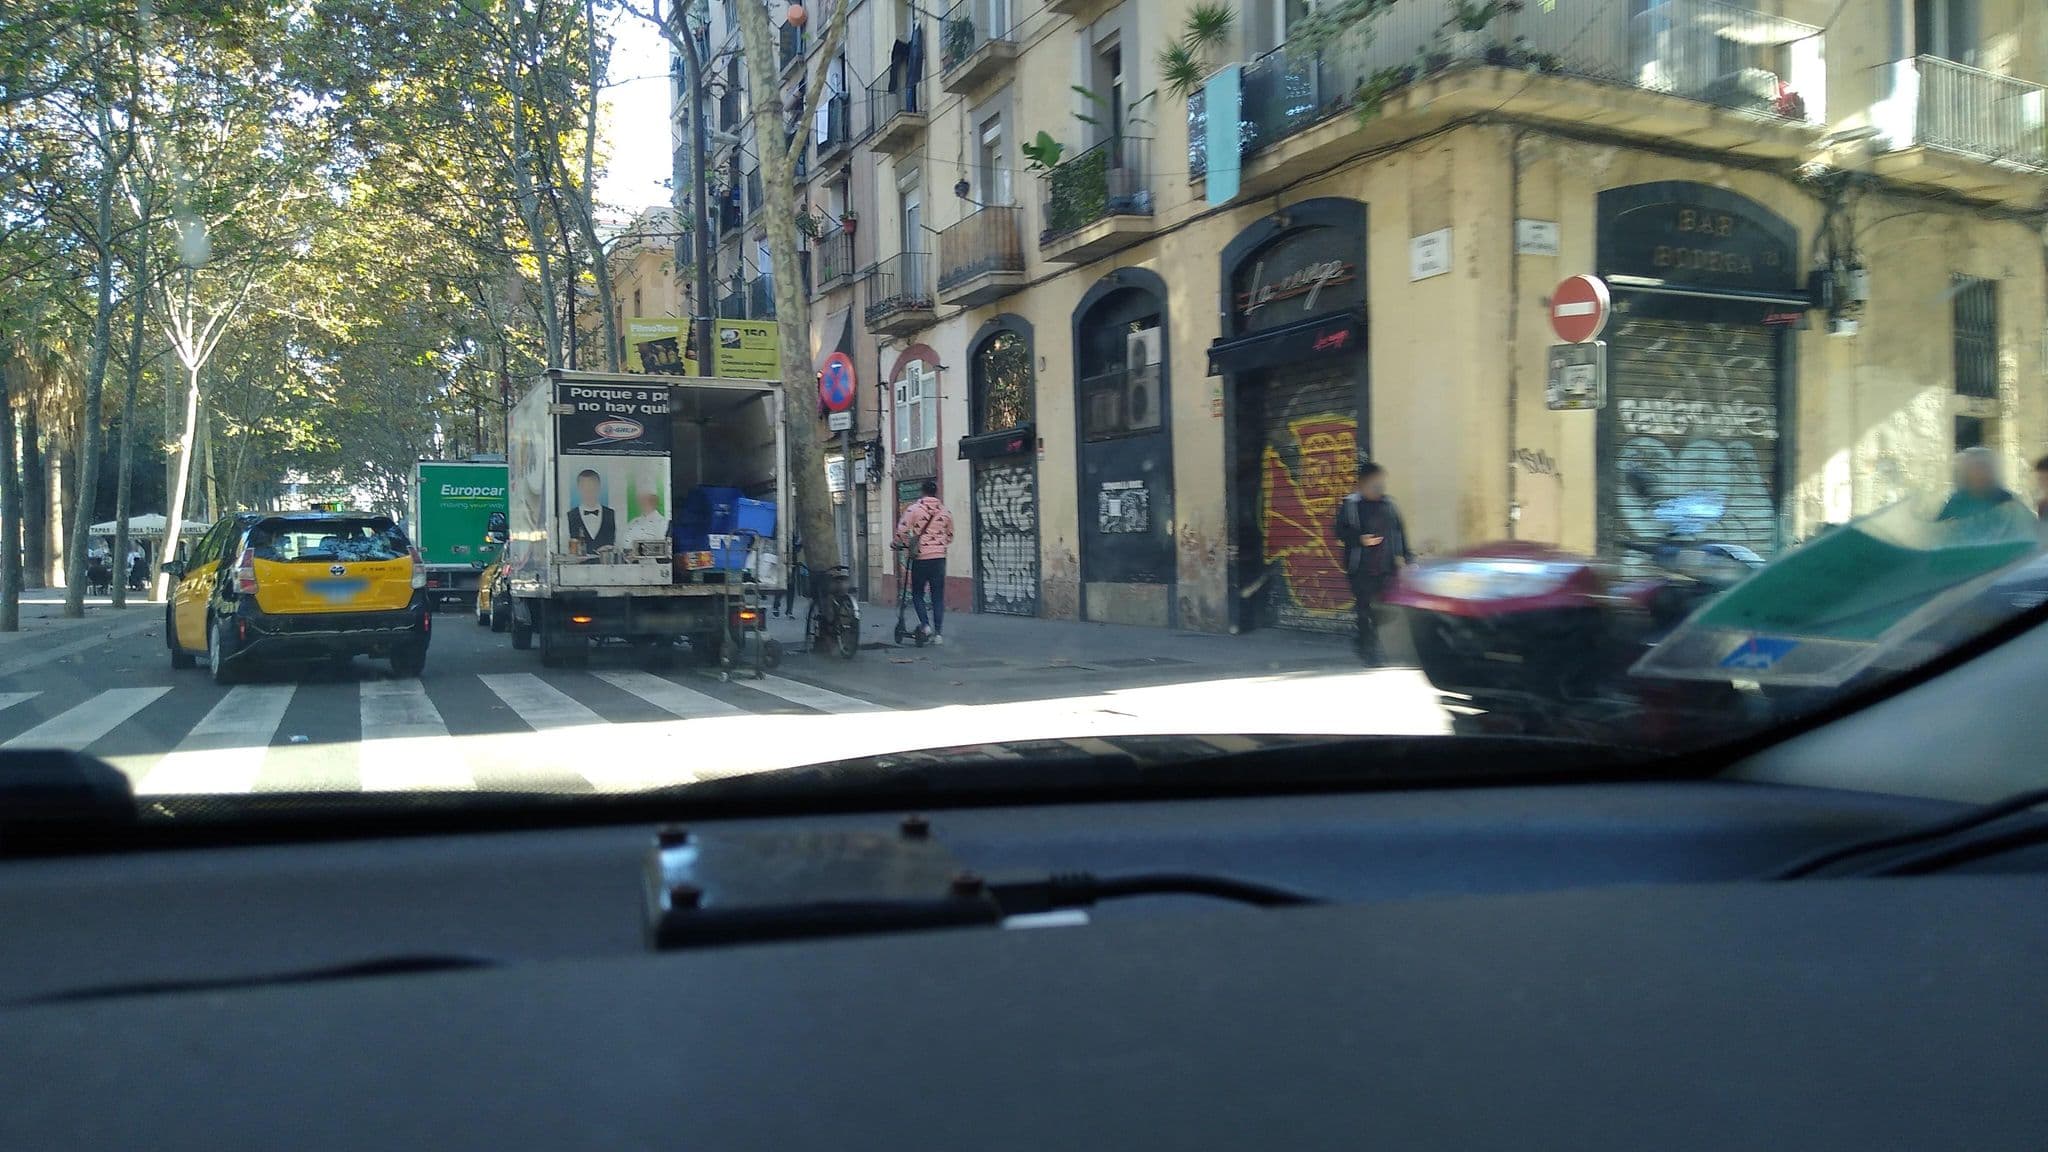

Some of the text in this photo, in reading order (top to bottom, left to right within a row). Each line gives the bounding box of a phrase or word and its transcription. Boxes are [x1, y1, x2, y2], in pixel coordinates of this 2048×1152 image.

[570, 387, 632, 400] Porque
[637, 391, 647, 400] a
[578, 402, 671, 415] no hay qui
[441, 484, 505, 498] Europcar
